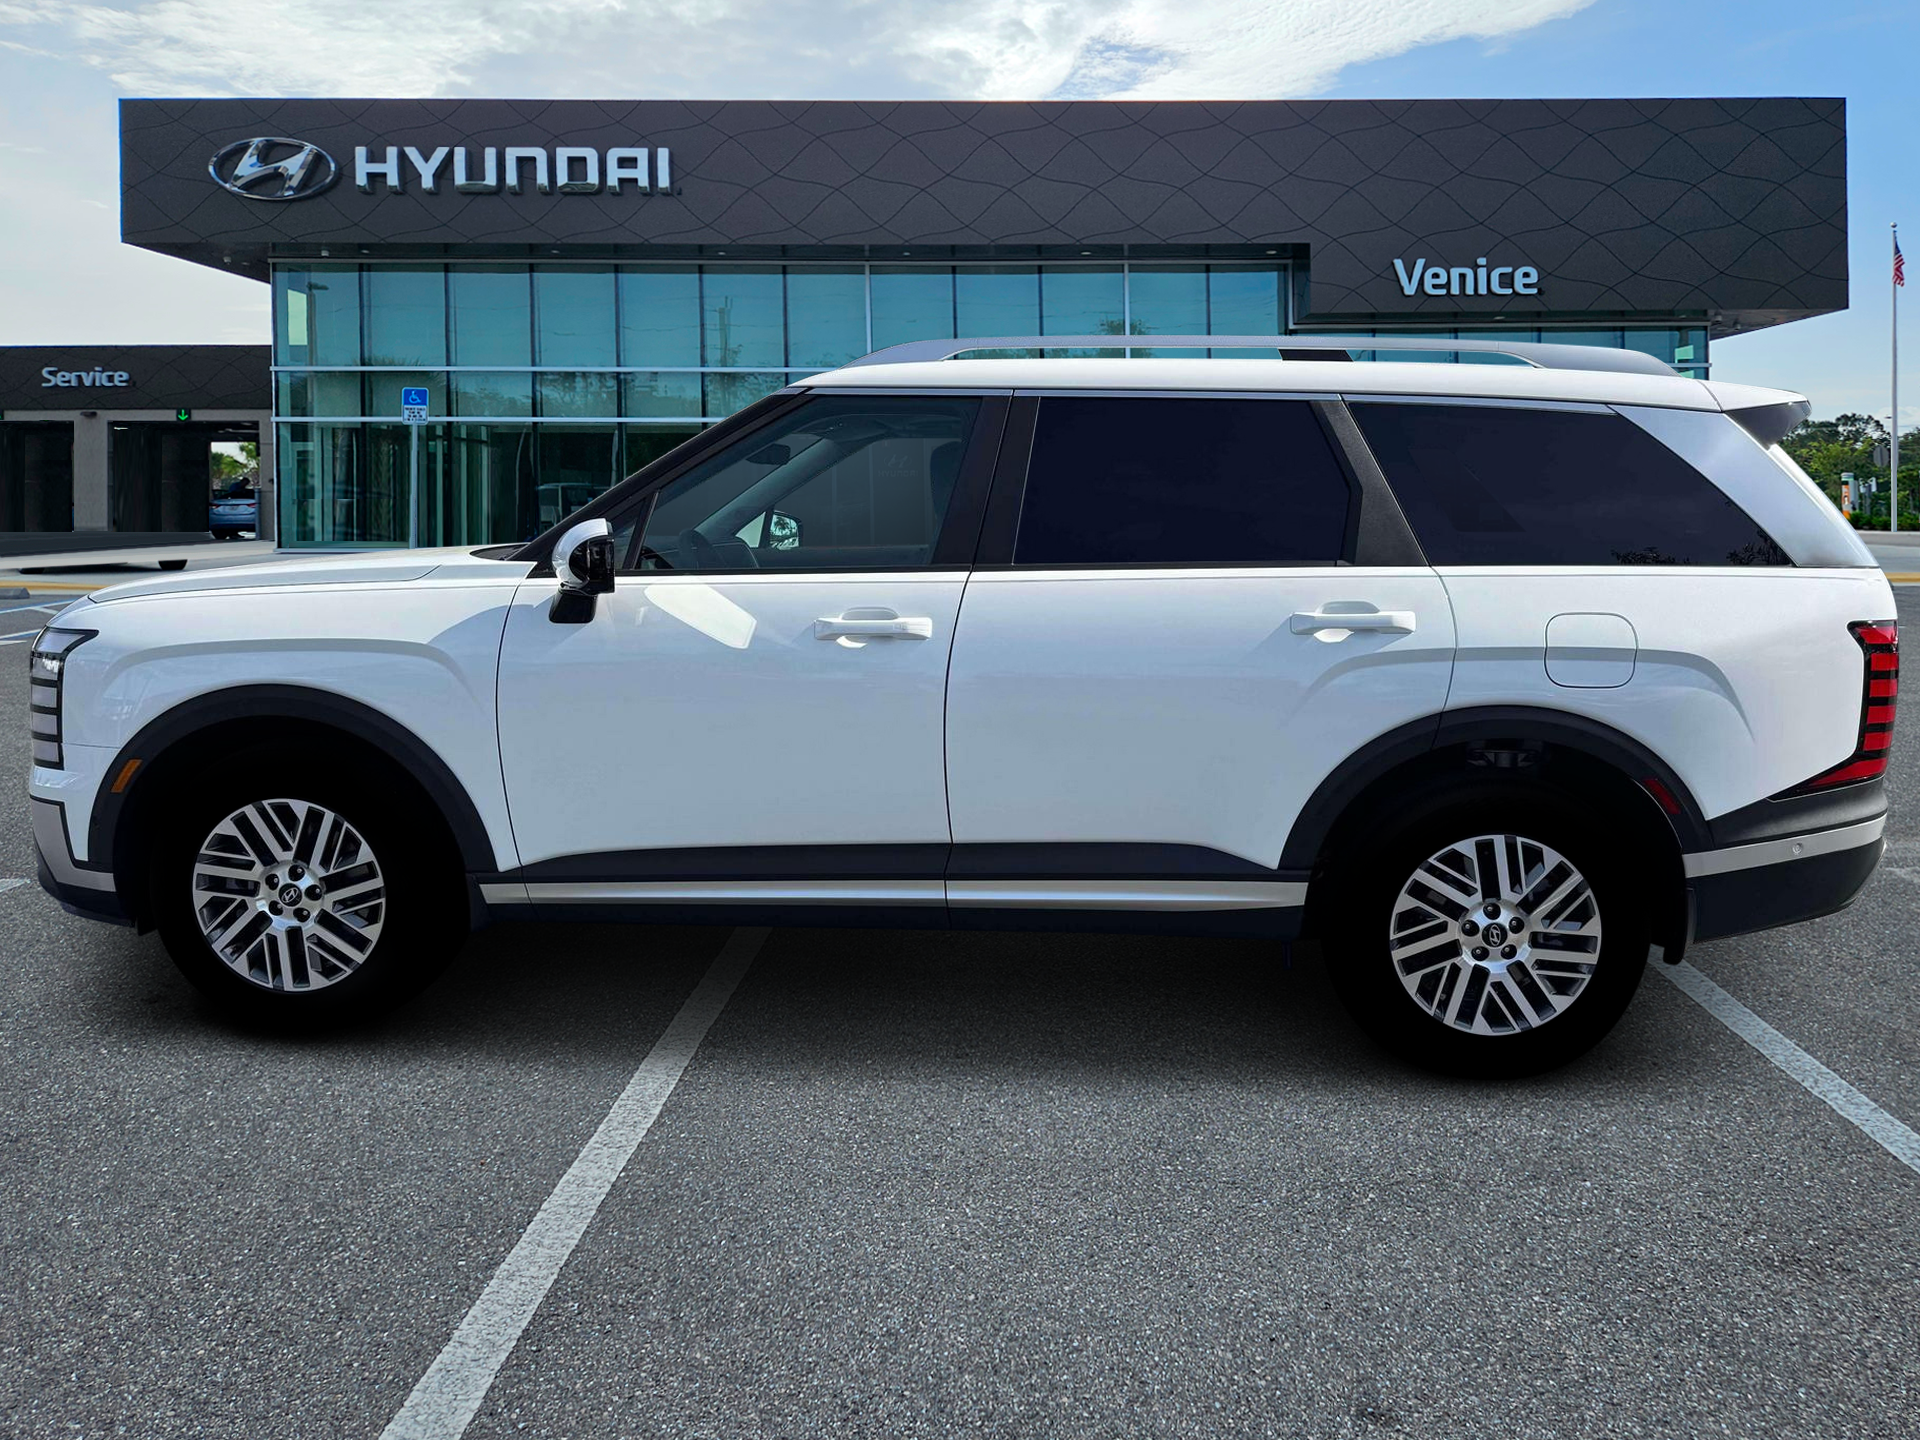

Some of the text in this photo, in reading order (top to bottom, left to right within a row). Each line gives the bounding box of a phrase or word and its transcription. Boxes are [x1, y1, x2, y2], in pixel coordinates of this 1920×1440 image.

[354, 146, 671, 193] HYUNDAI
[1392, 257, 1539, 296] Venice
[41, 366, 130, 387] Service
